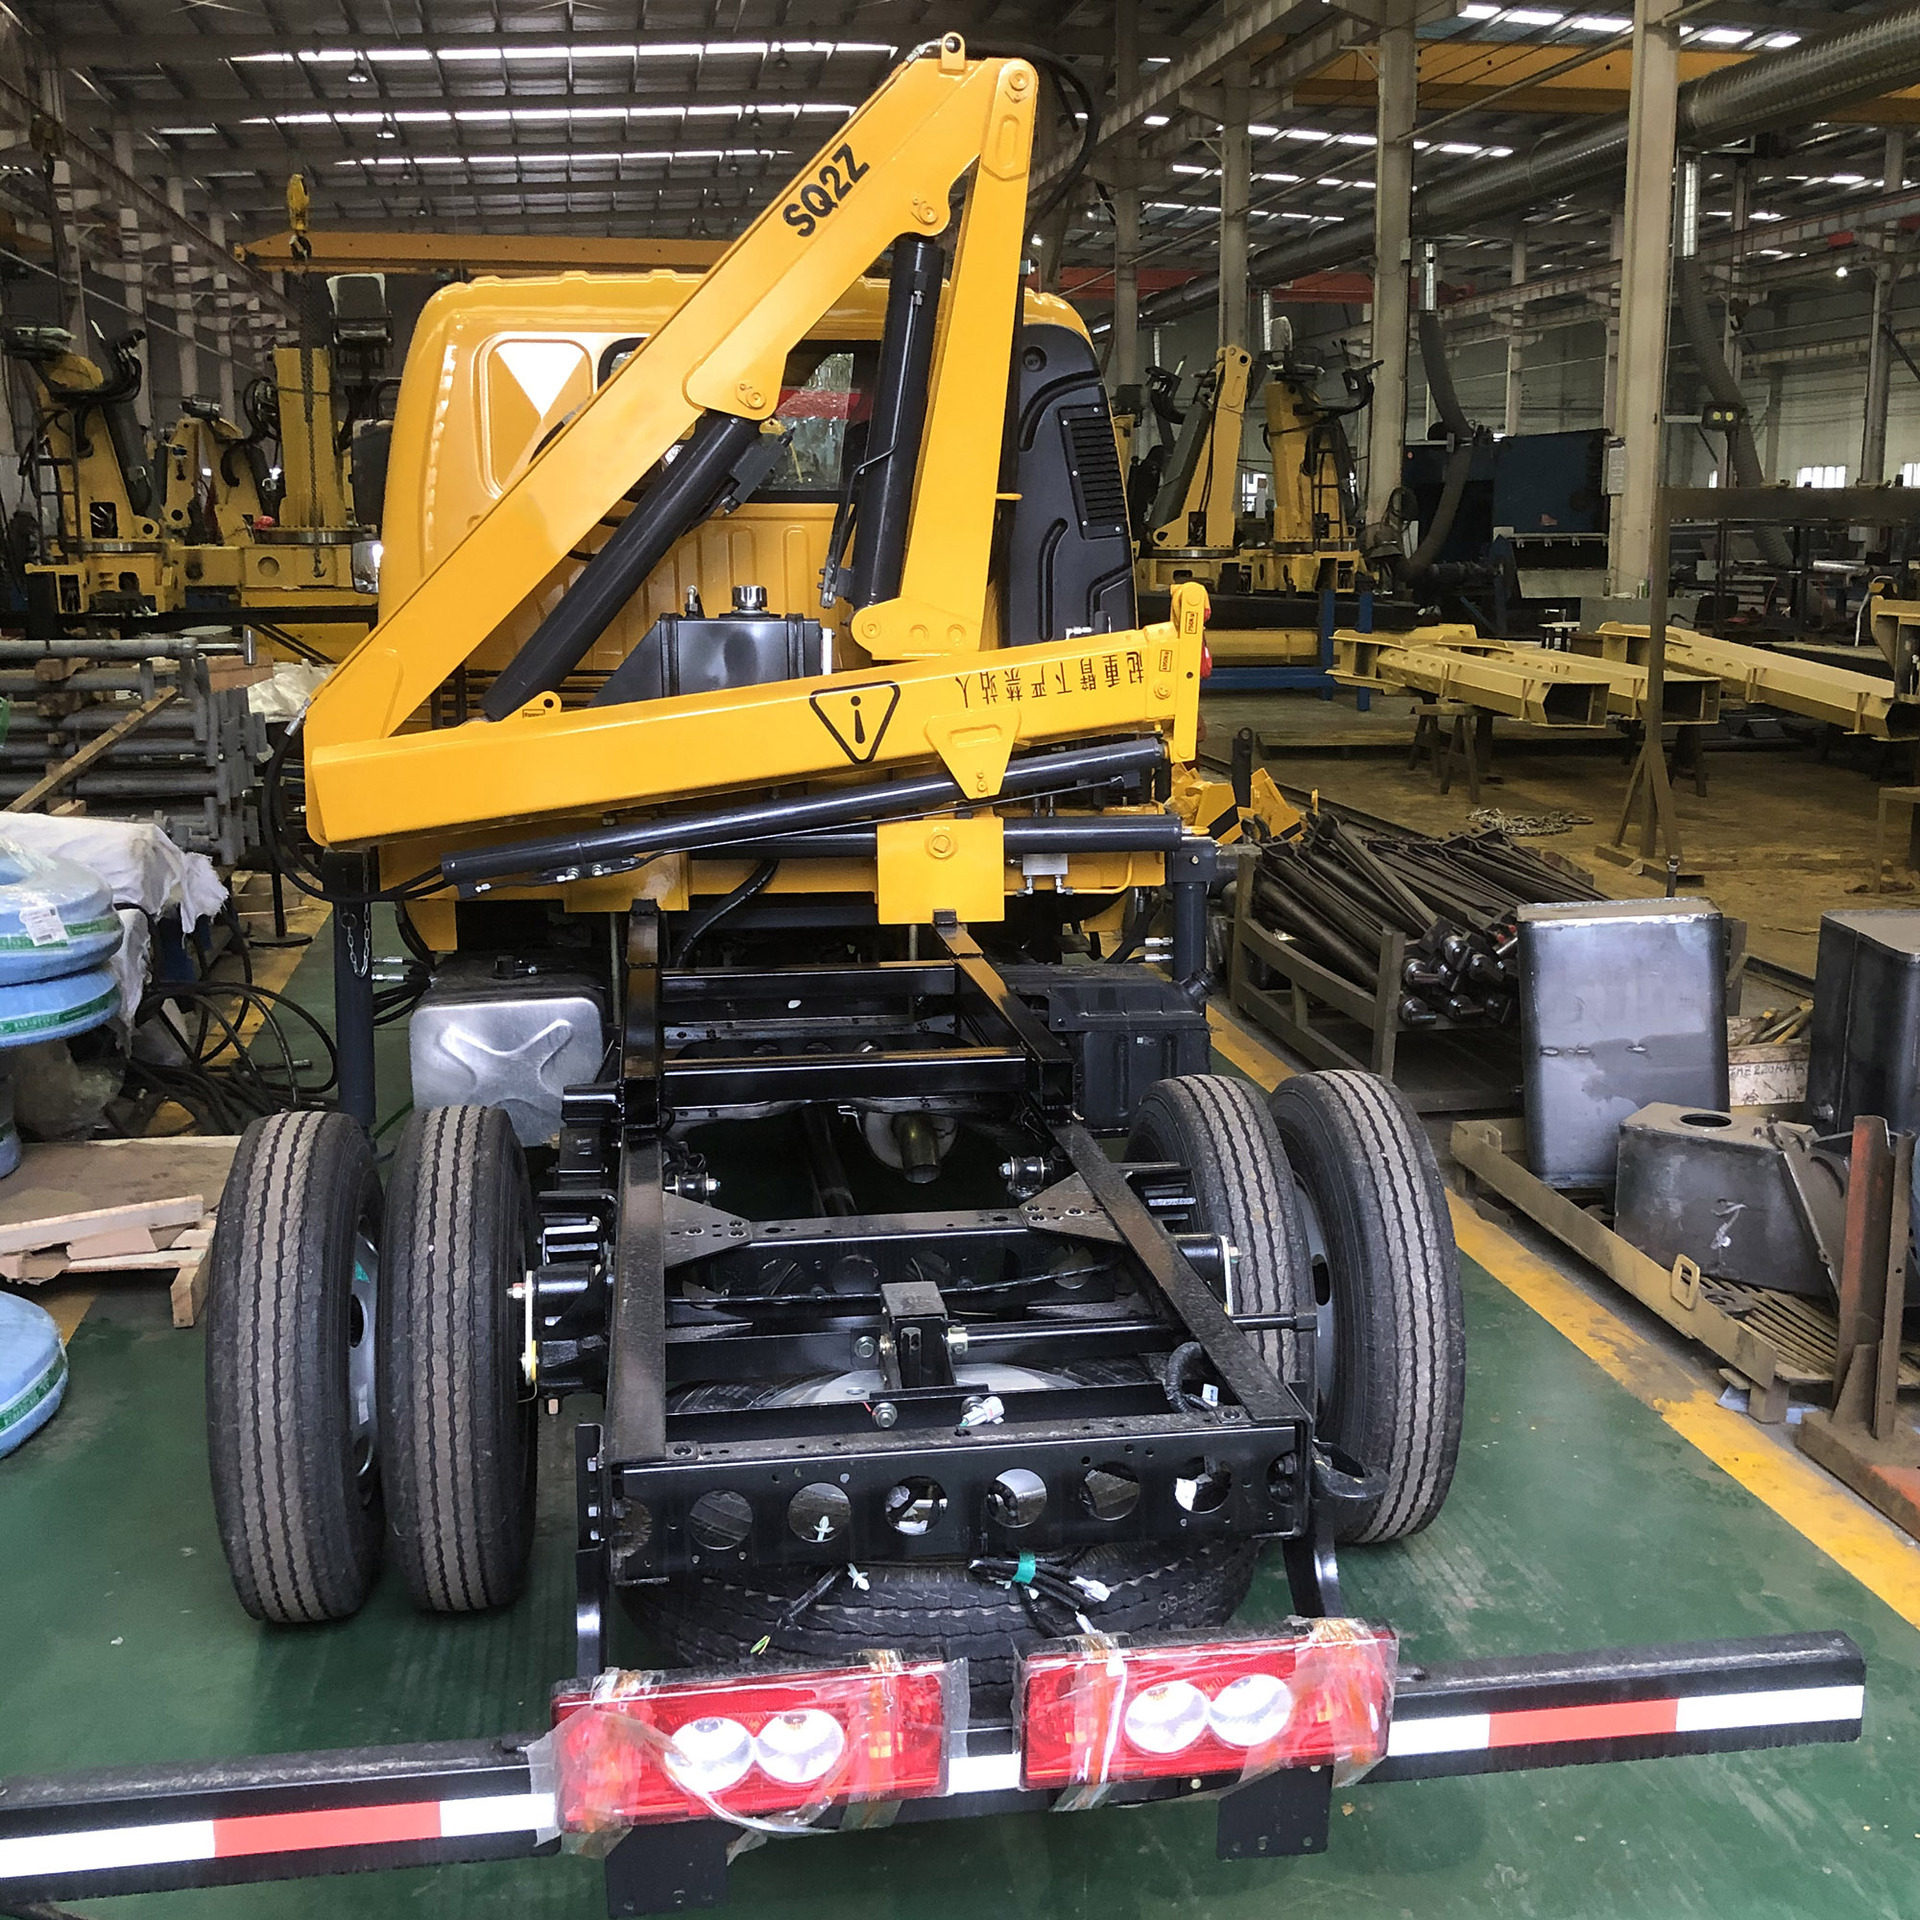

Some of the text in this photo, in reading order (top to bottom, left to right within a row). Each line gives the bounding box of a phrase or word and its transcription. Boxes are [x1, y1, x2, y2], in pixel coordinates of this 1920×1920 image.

[782, 142, 870, 237] SQ2Z
[955, 651, 1145, 708] 起重臂下严禁站人
